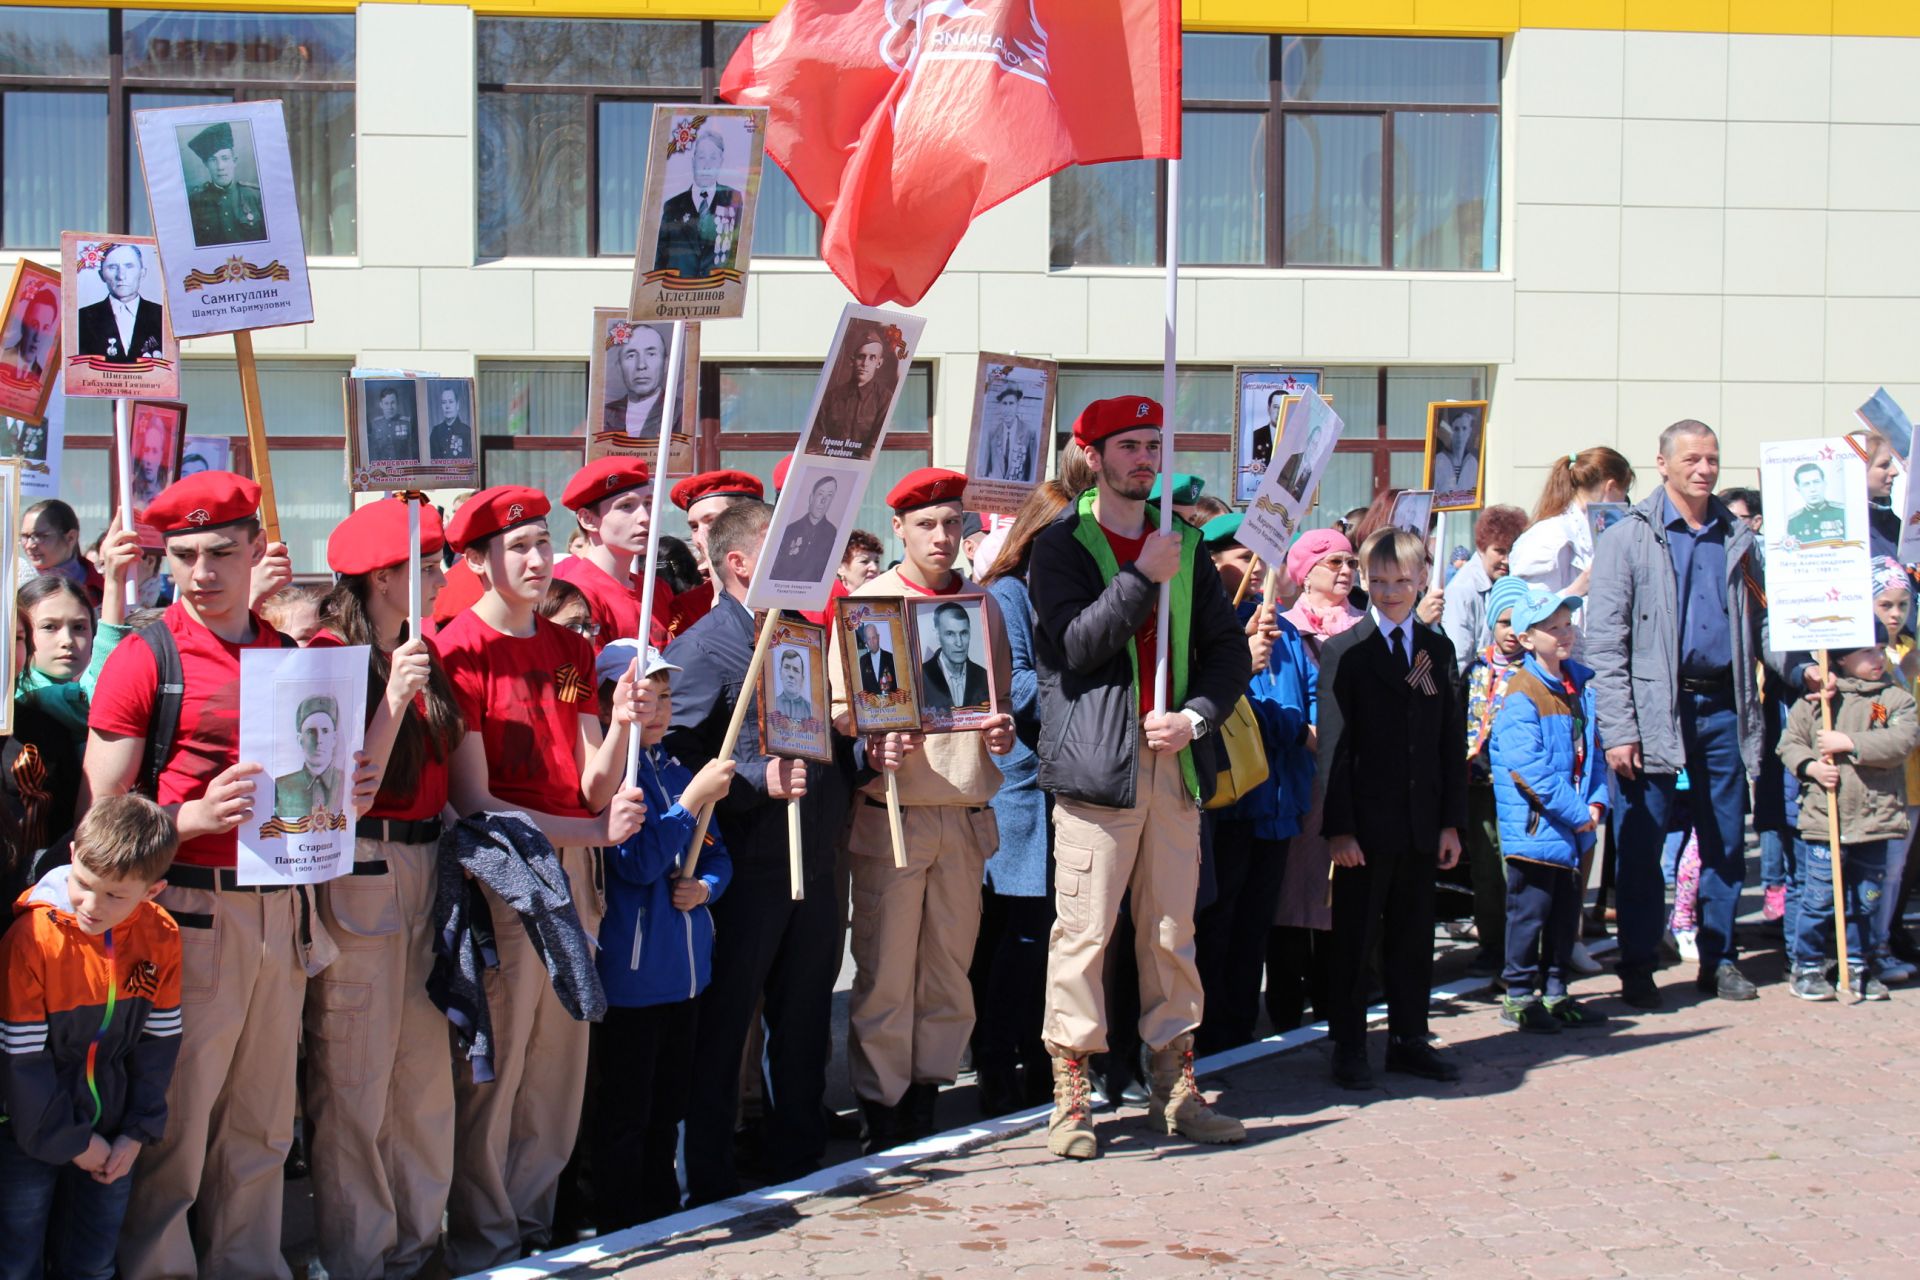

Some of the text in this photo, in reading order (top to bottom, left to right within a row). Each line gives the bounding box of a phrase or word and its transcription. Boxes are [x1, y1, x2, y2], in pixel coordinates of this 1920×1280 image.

[201, 288, 279, 305] Самигуллин
[655, 289, 725, 303] Аглетдинов
[191, 300, 292, 318] Шамгун Каримулович
[655, 304, 721, 317] Фатхутдин
[274, 856, 307, 865] Павел
